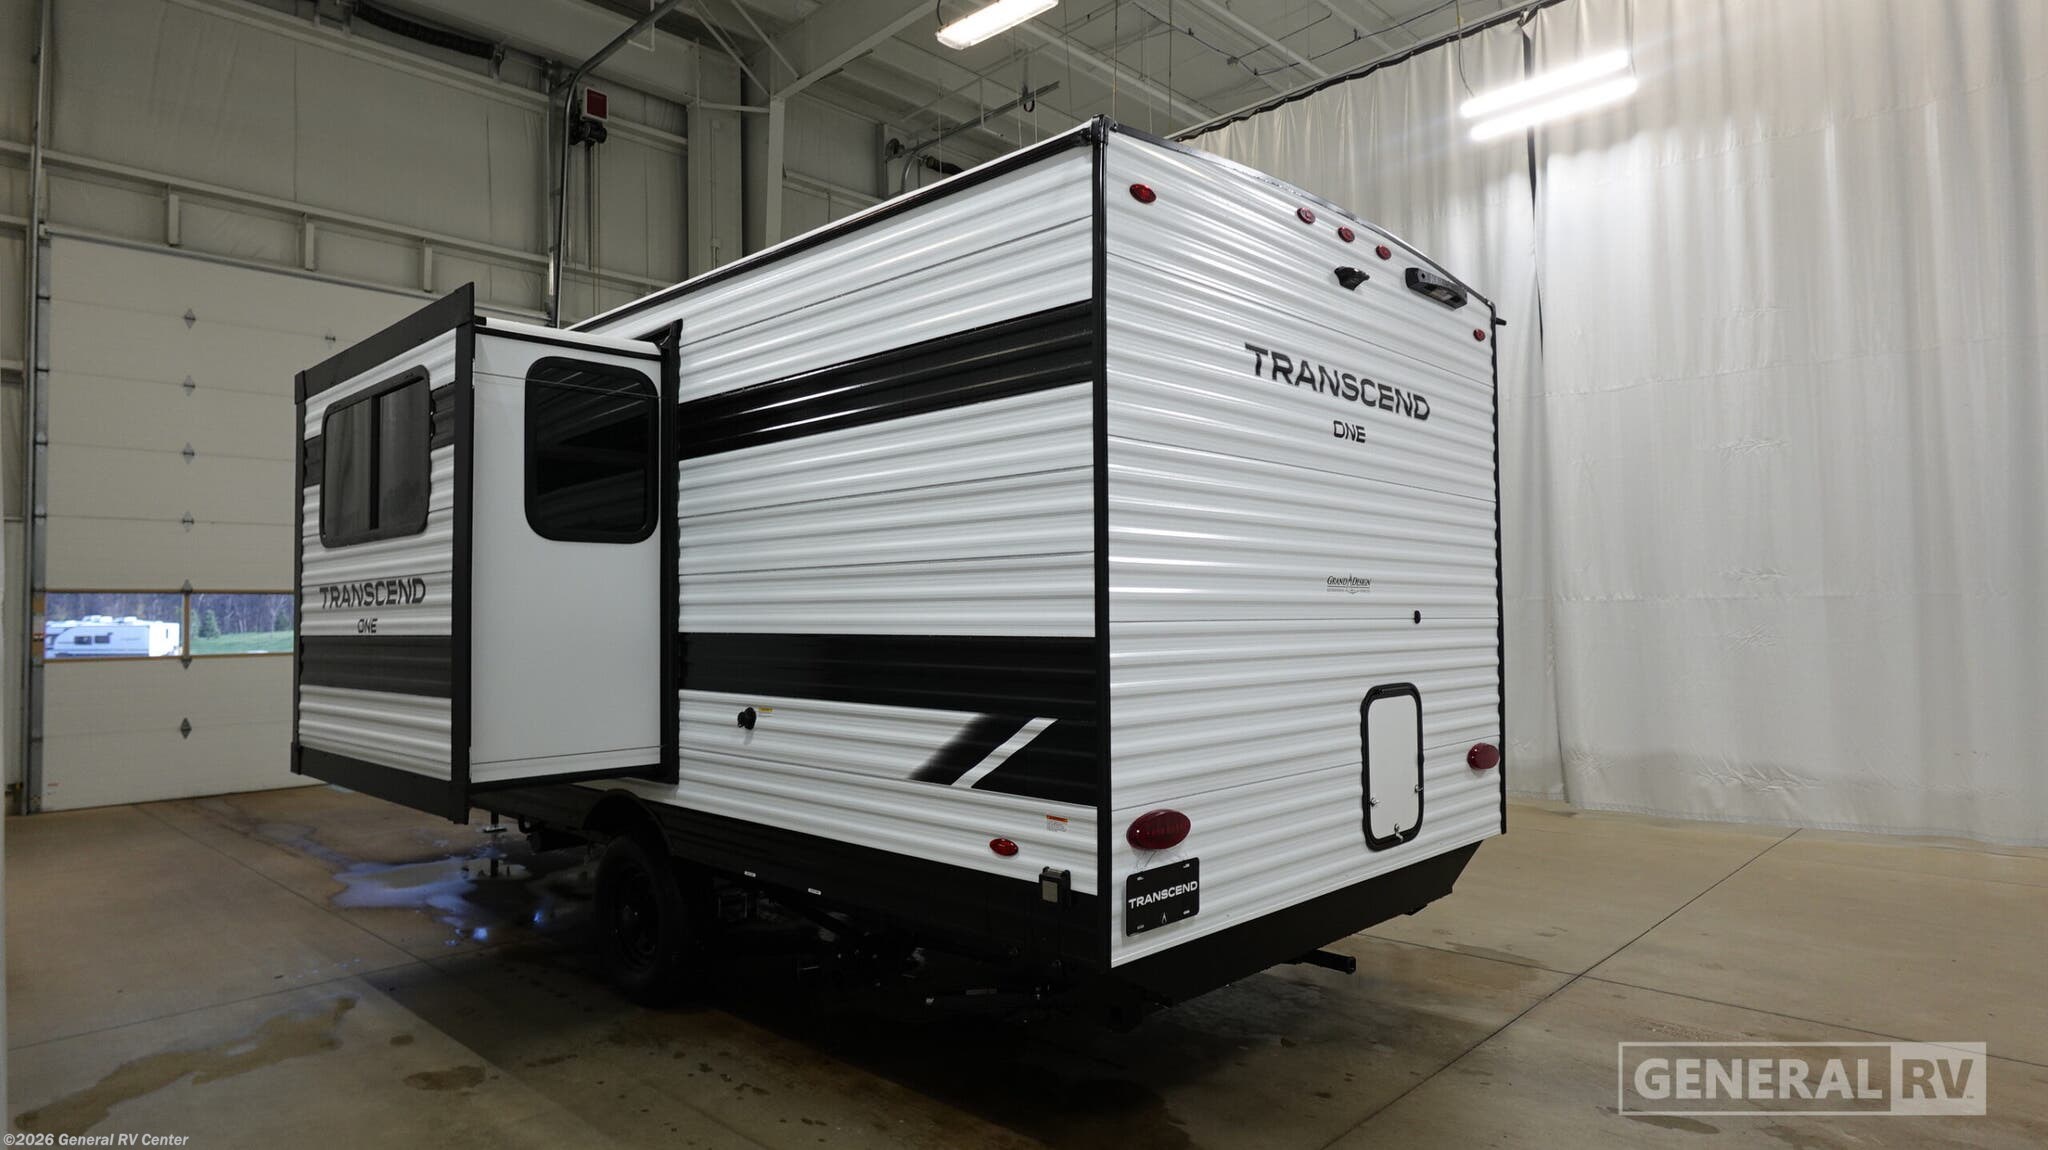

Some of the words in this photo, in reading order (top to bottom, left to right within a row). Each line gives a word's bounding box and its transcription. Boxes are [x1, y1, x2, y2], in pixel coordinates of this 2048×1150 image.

[1244, 342, 1431, 421] TRANSCEND
[1333, 420, 1366, 443] ONE
[319, 577, 426, 609] TRANSCEND
[357, 618, 378, 633] ONE
[1128, 881, 1198, 909] TRANSCEND
